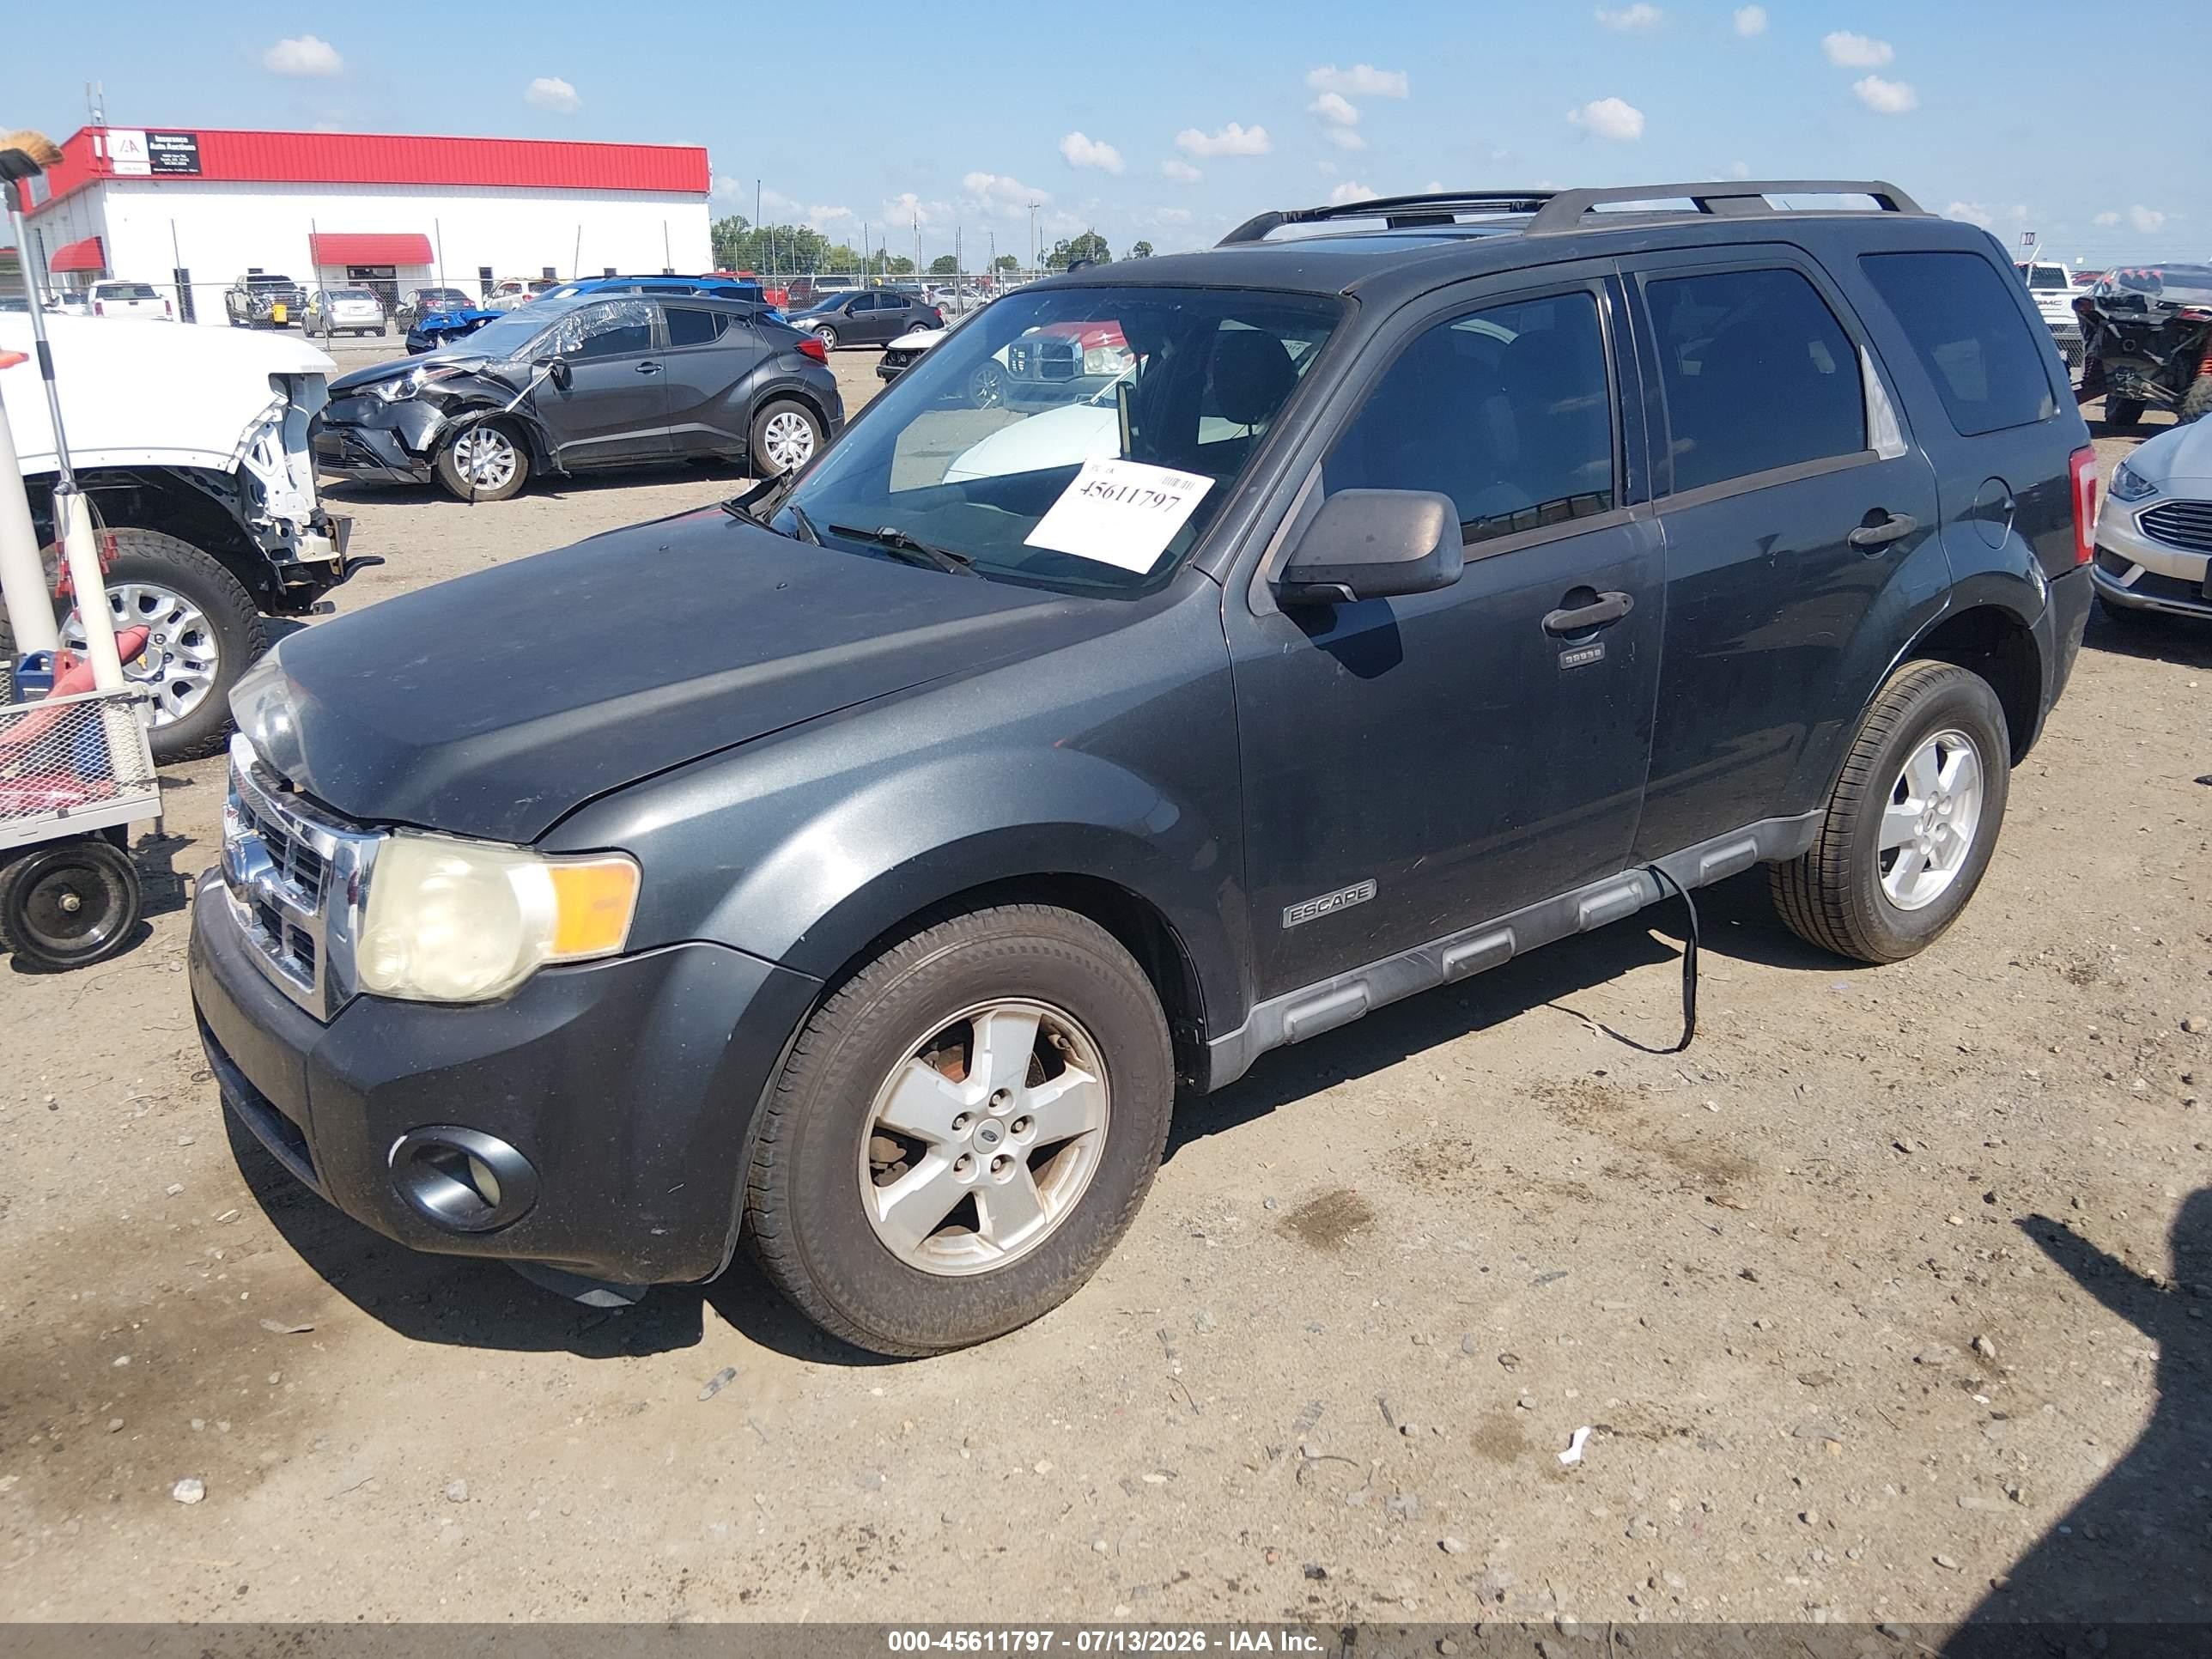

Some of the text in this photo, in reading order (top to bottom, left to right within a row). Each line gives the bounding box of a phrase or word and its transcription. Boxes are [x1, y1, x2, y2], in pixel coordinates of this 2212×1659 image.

[149, 142, 197, 151] Auto Auctions
[155, 135, 188, 143] Insurance
[1079, 480, 1182, 513] 45611797
[1289, 884, 1370, 923] ESCAPE
